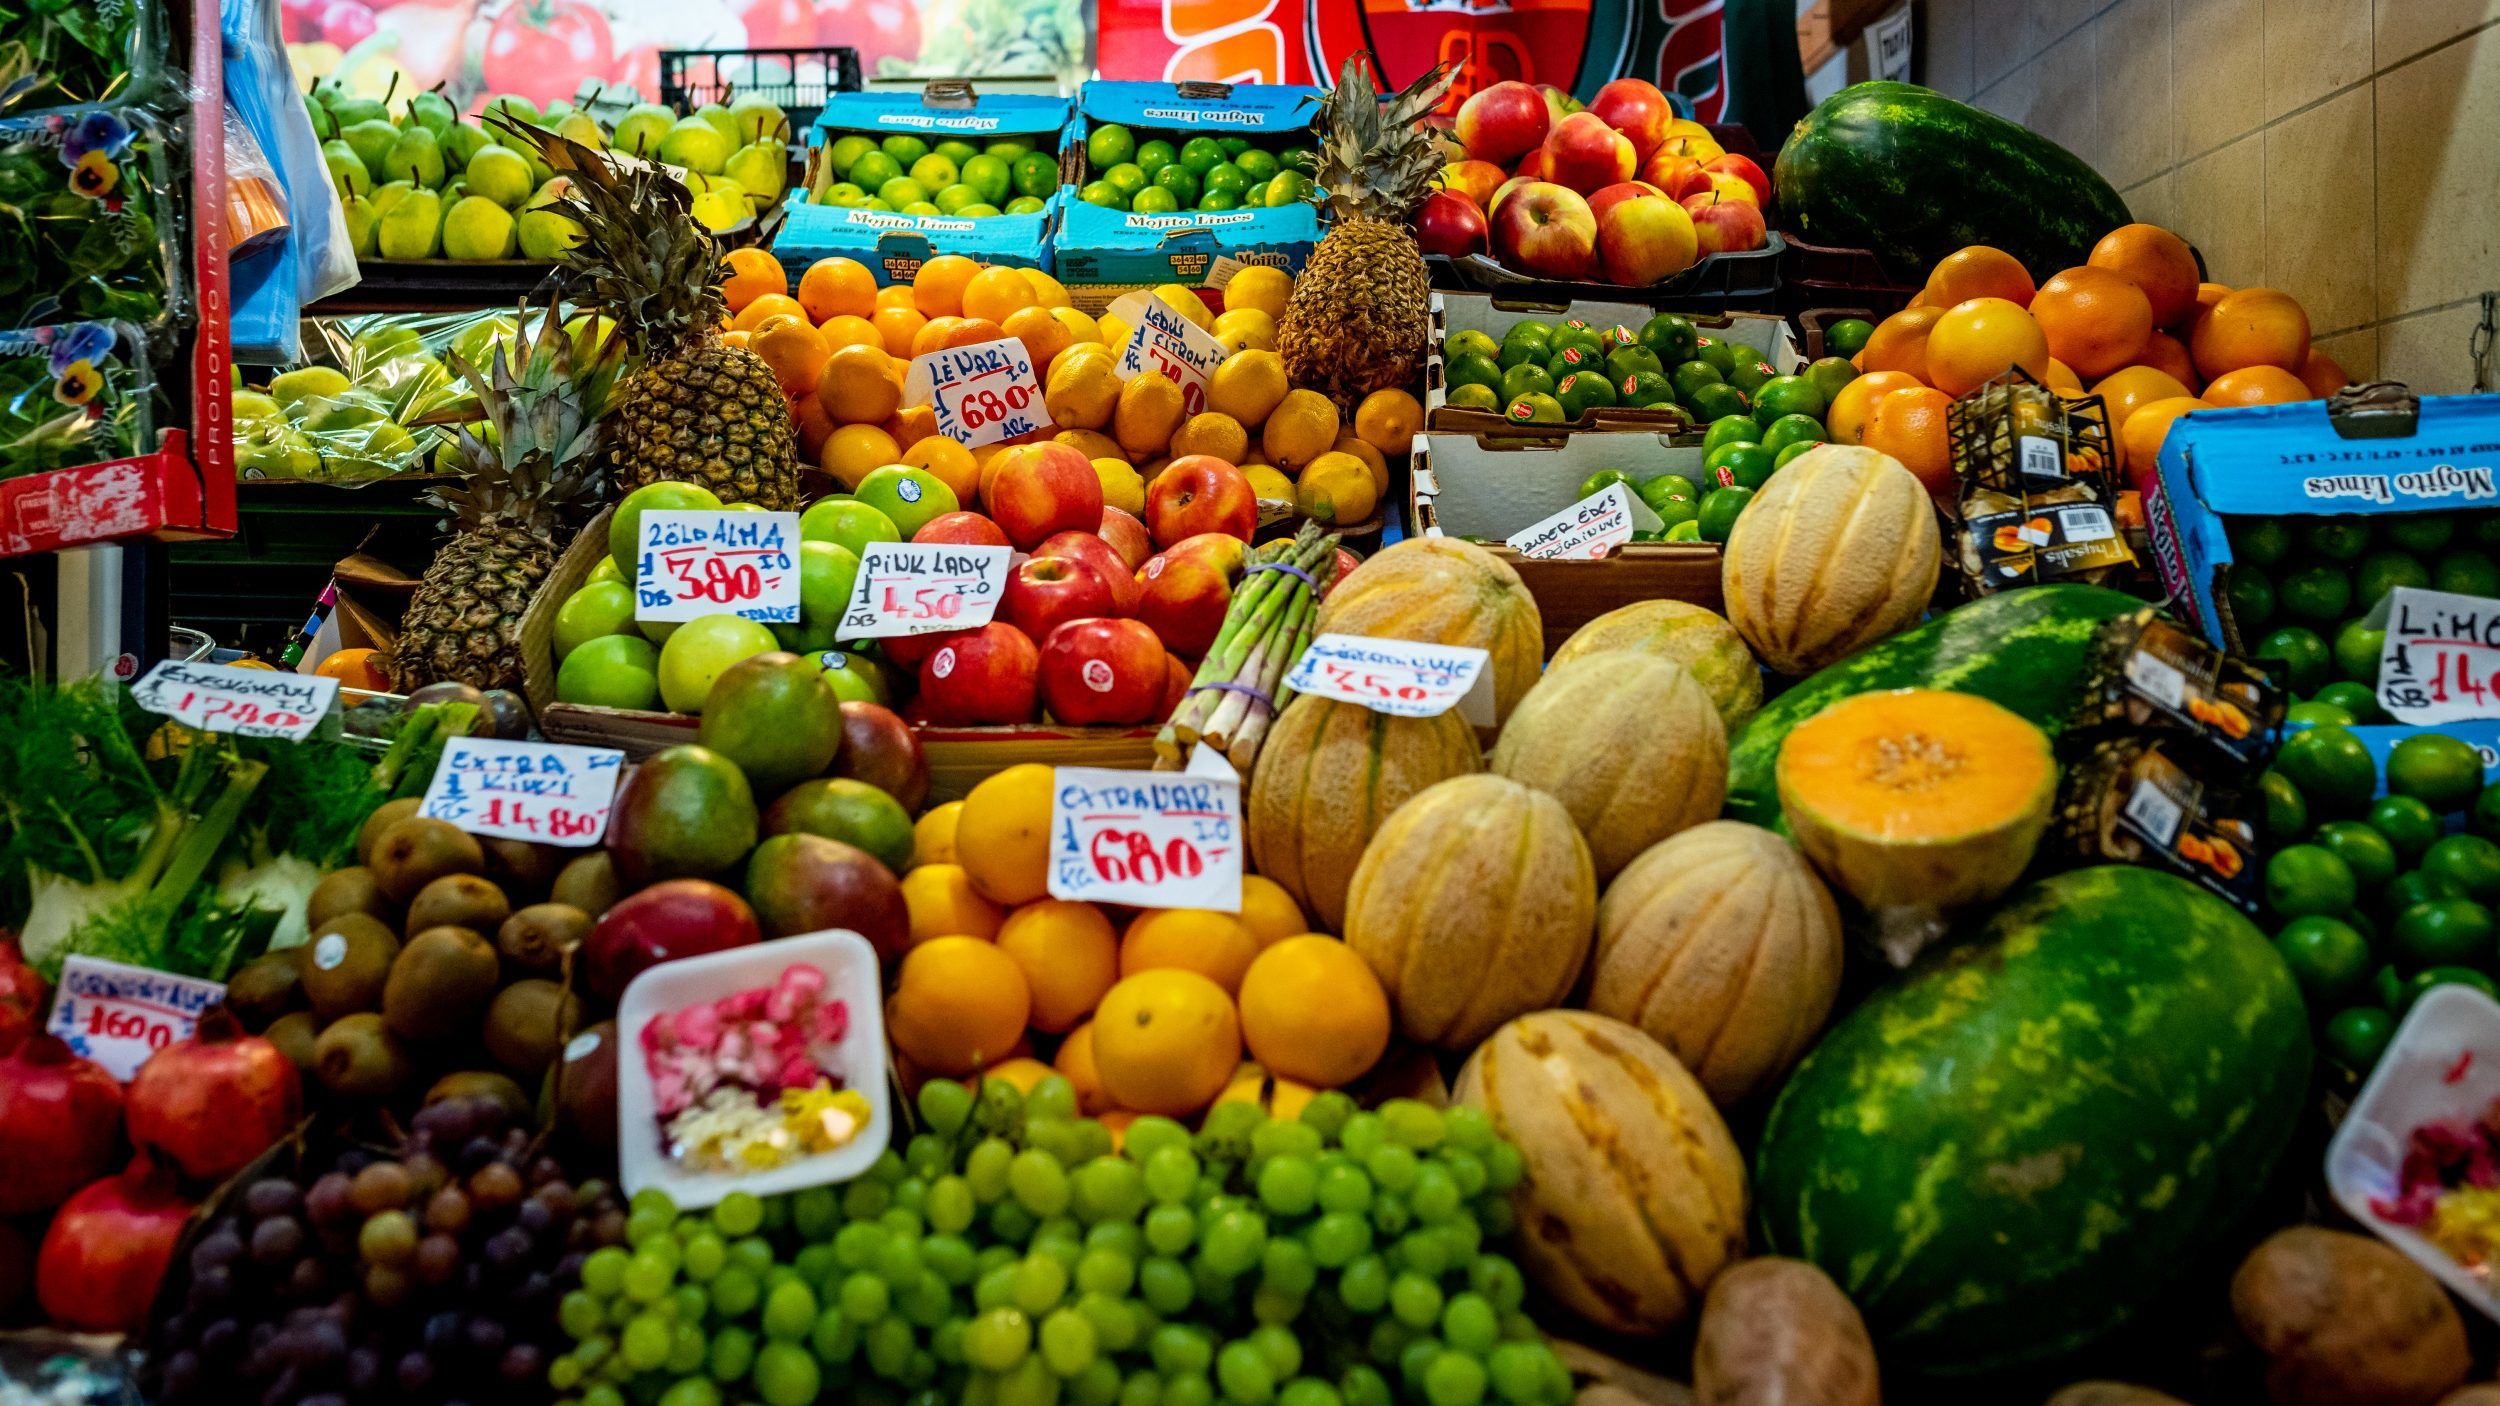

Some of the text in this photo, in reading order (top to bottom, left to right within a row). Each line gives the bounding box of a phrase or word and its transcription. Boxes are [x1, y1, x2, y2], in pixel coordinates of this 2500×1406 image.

[939, 117, 995, 129] Mojito
[1145, 109, 1262, 124] Mojito Limes
[851, 213, 974, 231] Mojito Limes
[1128, 213, 1252, 229] Mojito Limes
[1196, 255, 1207, 263] 48
[206, 135, 221, 465] PRODOTTO ITALIANO
[2308, 465, 2494, 500] Mojito Limes
[713, 518, 785, 550] ALMA
[933, 551, 991, 580] LADY
[638, 588, 673, 607] DB
[845, 613, 878, 627] DB
